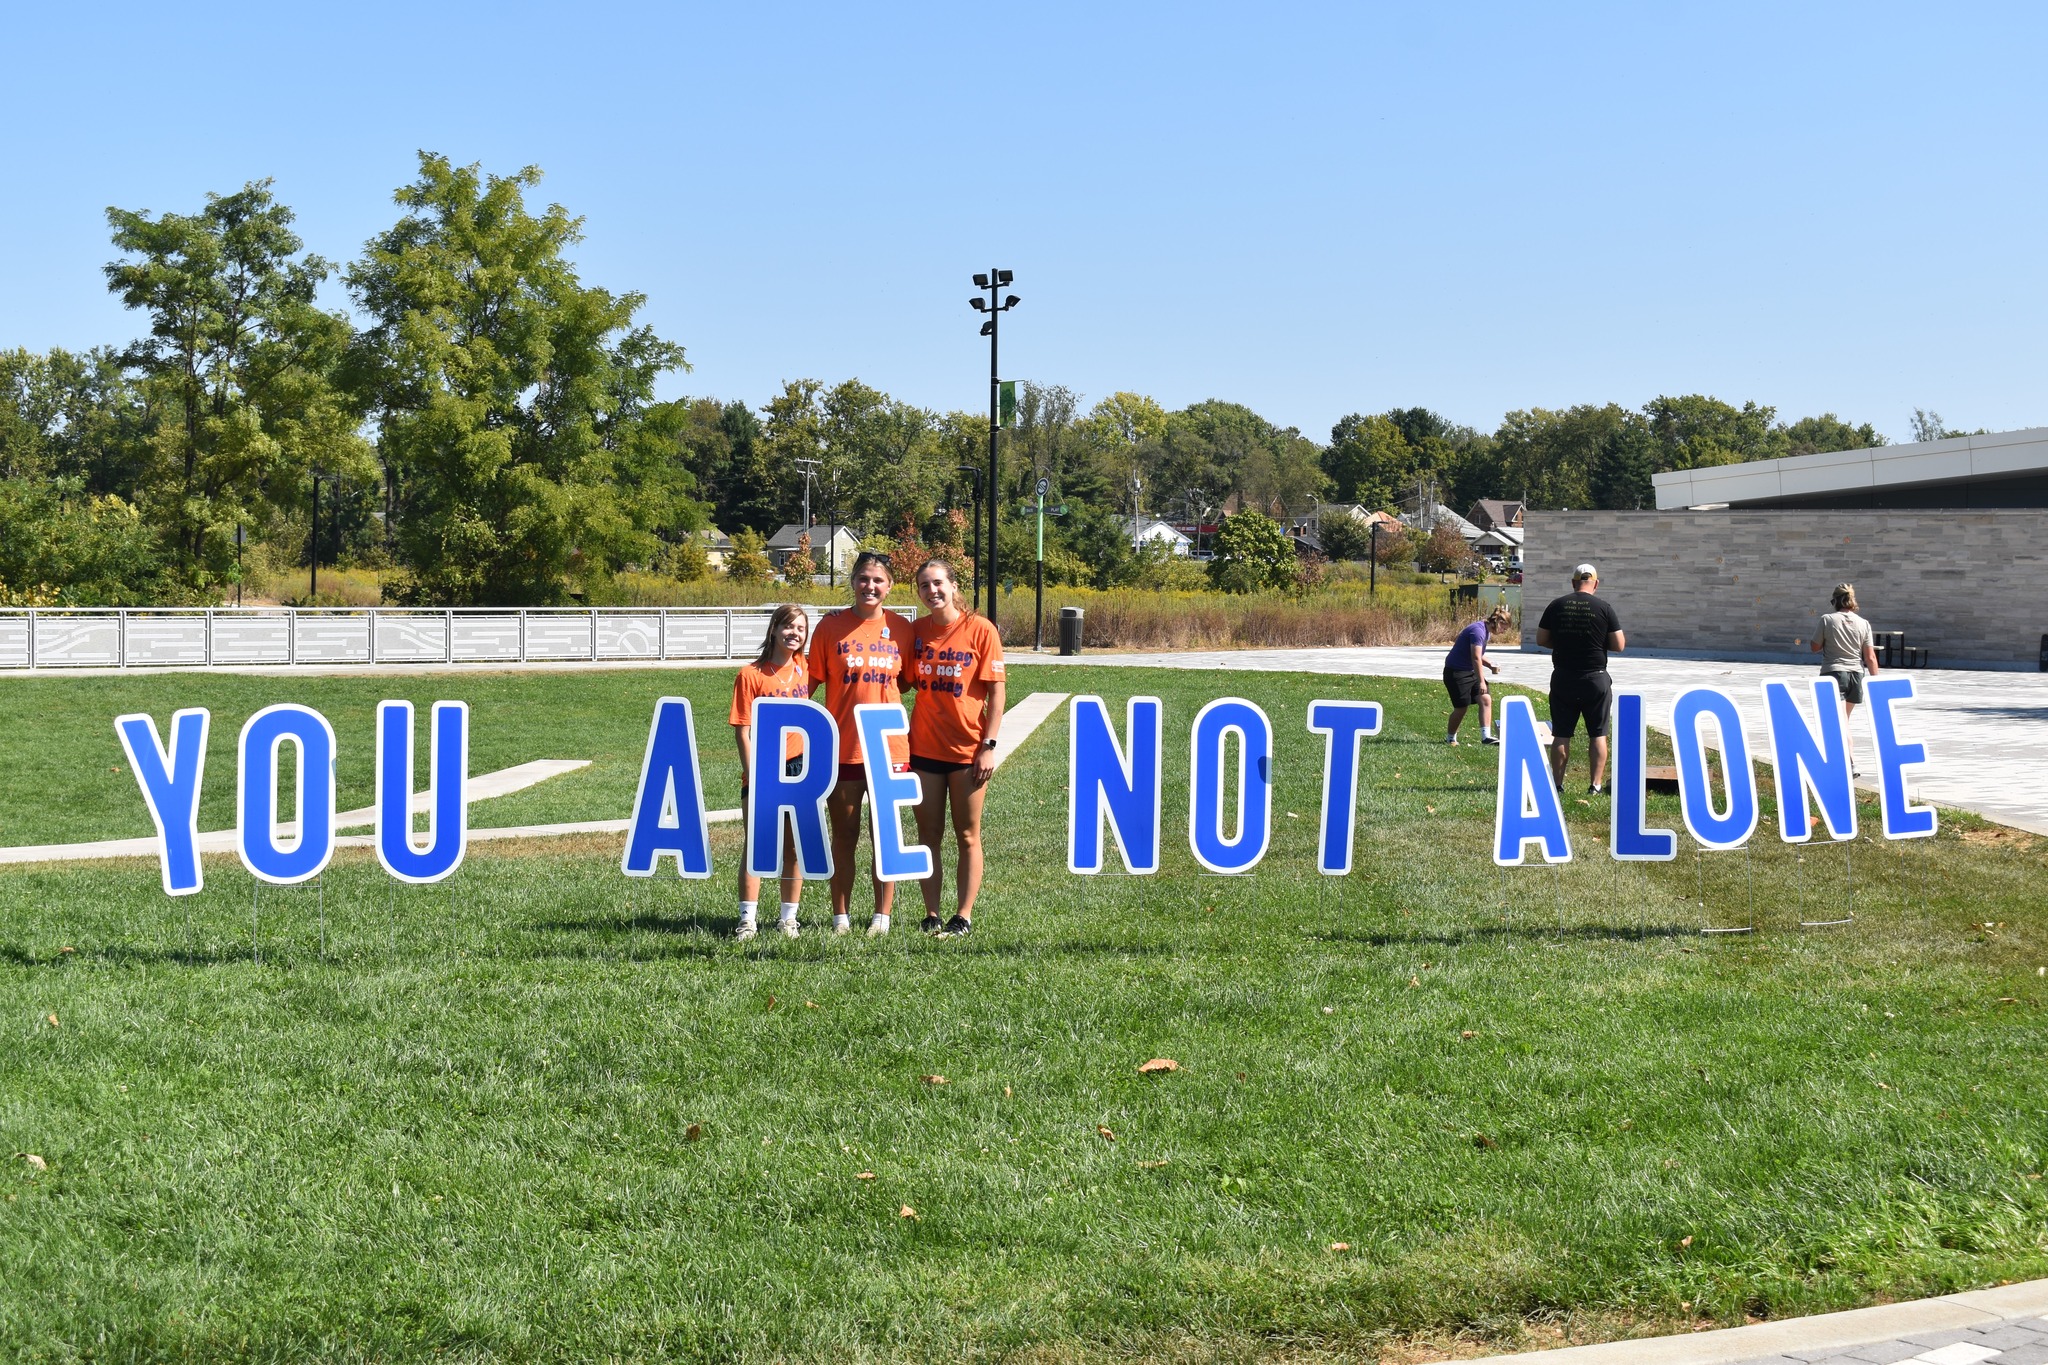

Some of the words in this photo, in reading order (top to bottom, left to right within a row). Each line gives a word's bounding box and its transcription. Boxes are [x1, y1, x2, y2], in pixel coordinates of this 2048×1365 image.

[869, 640, 900, 661] okay
[939, 647, 973, 667] okay
[846, 653, 864, 668] to
[868, 655, 893, 670] not
[918, 660, 932, 675] to
[936, 663, 962, 677] not
[863, 668, 892, 690] okay
[931, 677, 963, 698] okay
[114, 699, 469, 896] YOU
[620, 695, 934, 882] ARE
[1067, 695, 1383, 876] NOT
[1492, 674, 1938, 867] ALONE
